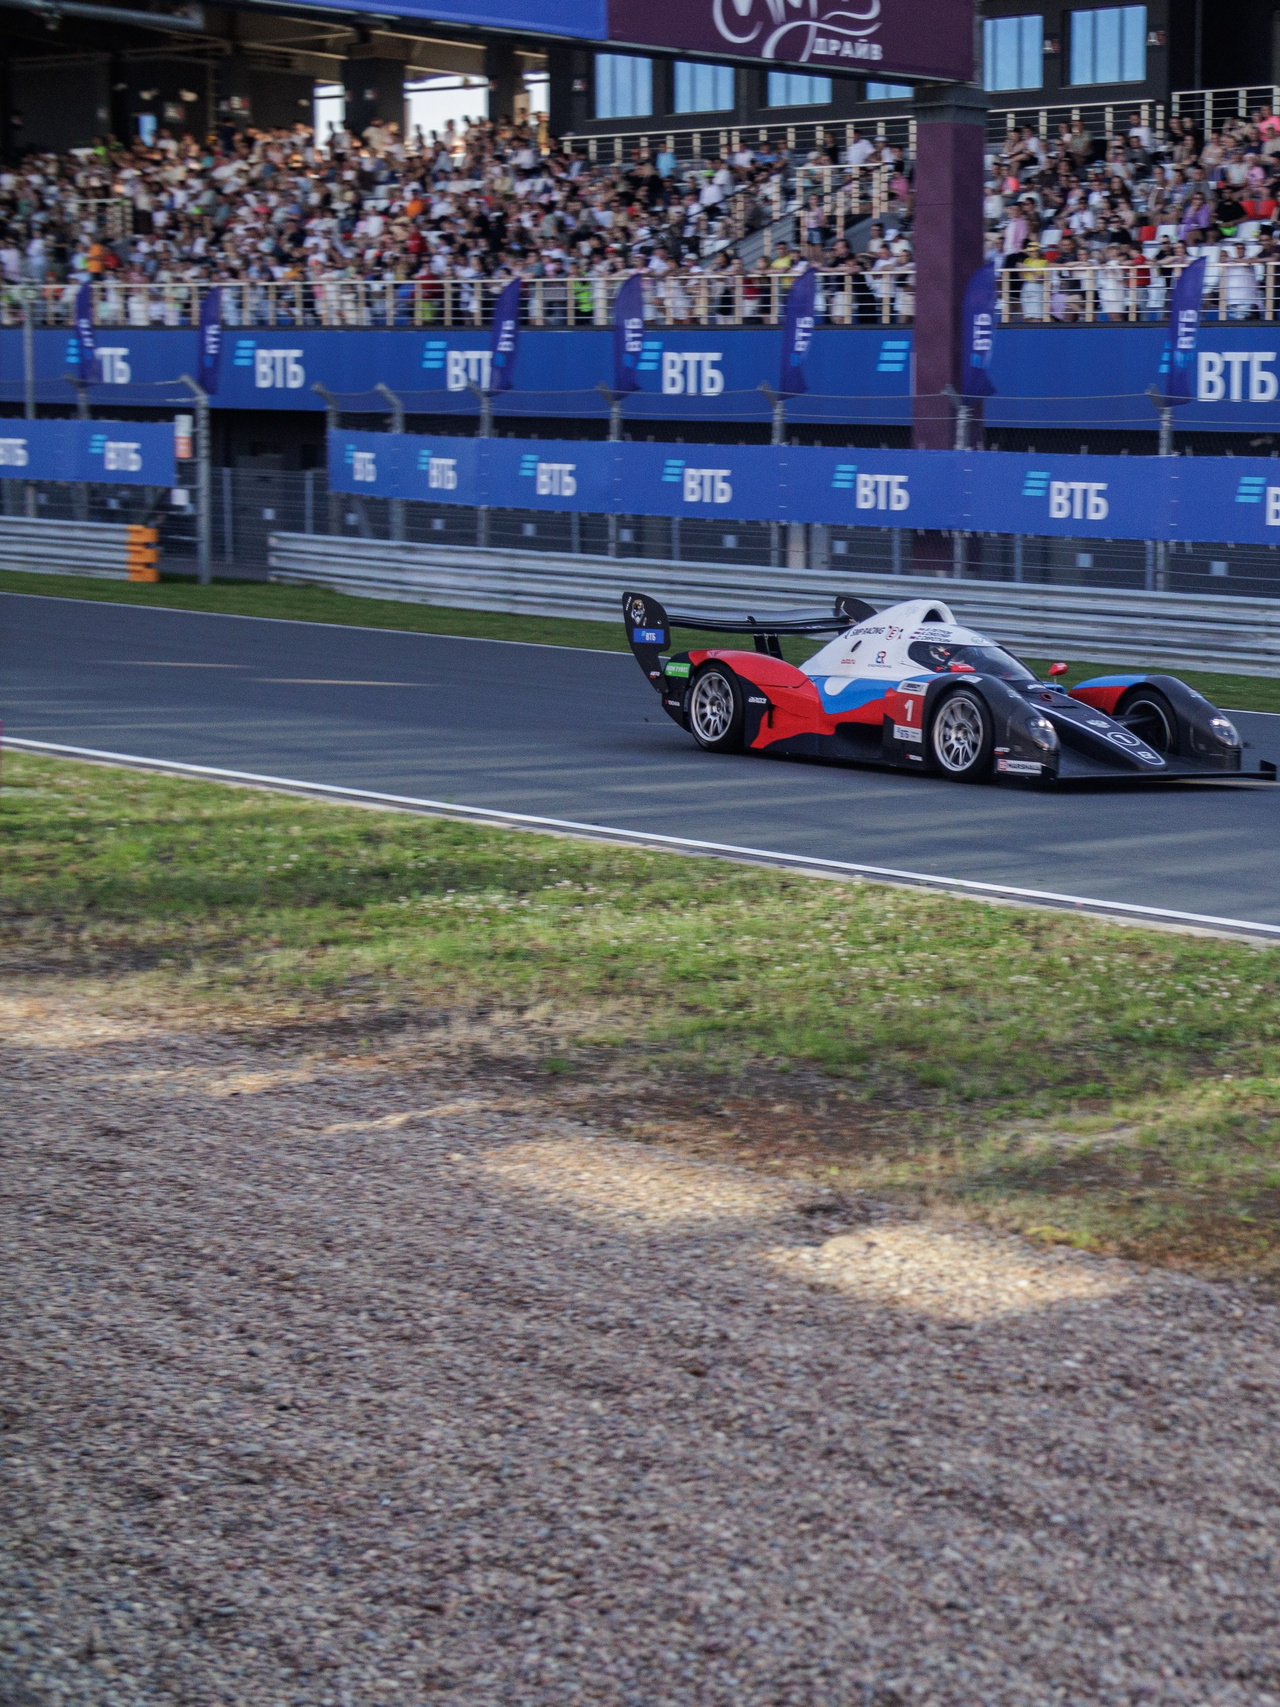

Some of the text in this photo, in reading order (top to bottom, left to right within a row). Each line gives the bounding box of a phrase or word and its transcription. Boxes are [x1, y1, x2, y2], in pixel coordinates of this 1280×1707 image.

[813, 38, 883, 60] ДРАЙВ
[624, 317, 643, 352] ВТБ
[794, 316, 815, 352] ВТБ
[972, 313, 993, 351] ВТБ
[1176, 309, 1198, 349] ВТБ
[95, 347, 131, 384] ТБ
[255, 349, 305, 389] ВТБ
[662, 352, 724, 396] ВТБ
[1197, 352, 1279, 402] ВТБ
[104, 441, 142, 472] ВТБ
[353, 451, 377, 483] ВТБ
[428, 457, 458, 490] ВТБ
[536, 462, 577, 497] ВТБ
[683, 468, 733, 504] ВТБ
[856, 473, 910, 511] ВТБ
[1049, 481, 1110, 520] ВТБ
[645, 632, 656, 641] ВТБ
[904, 699, 914, 721] 1
